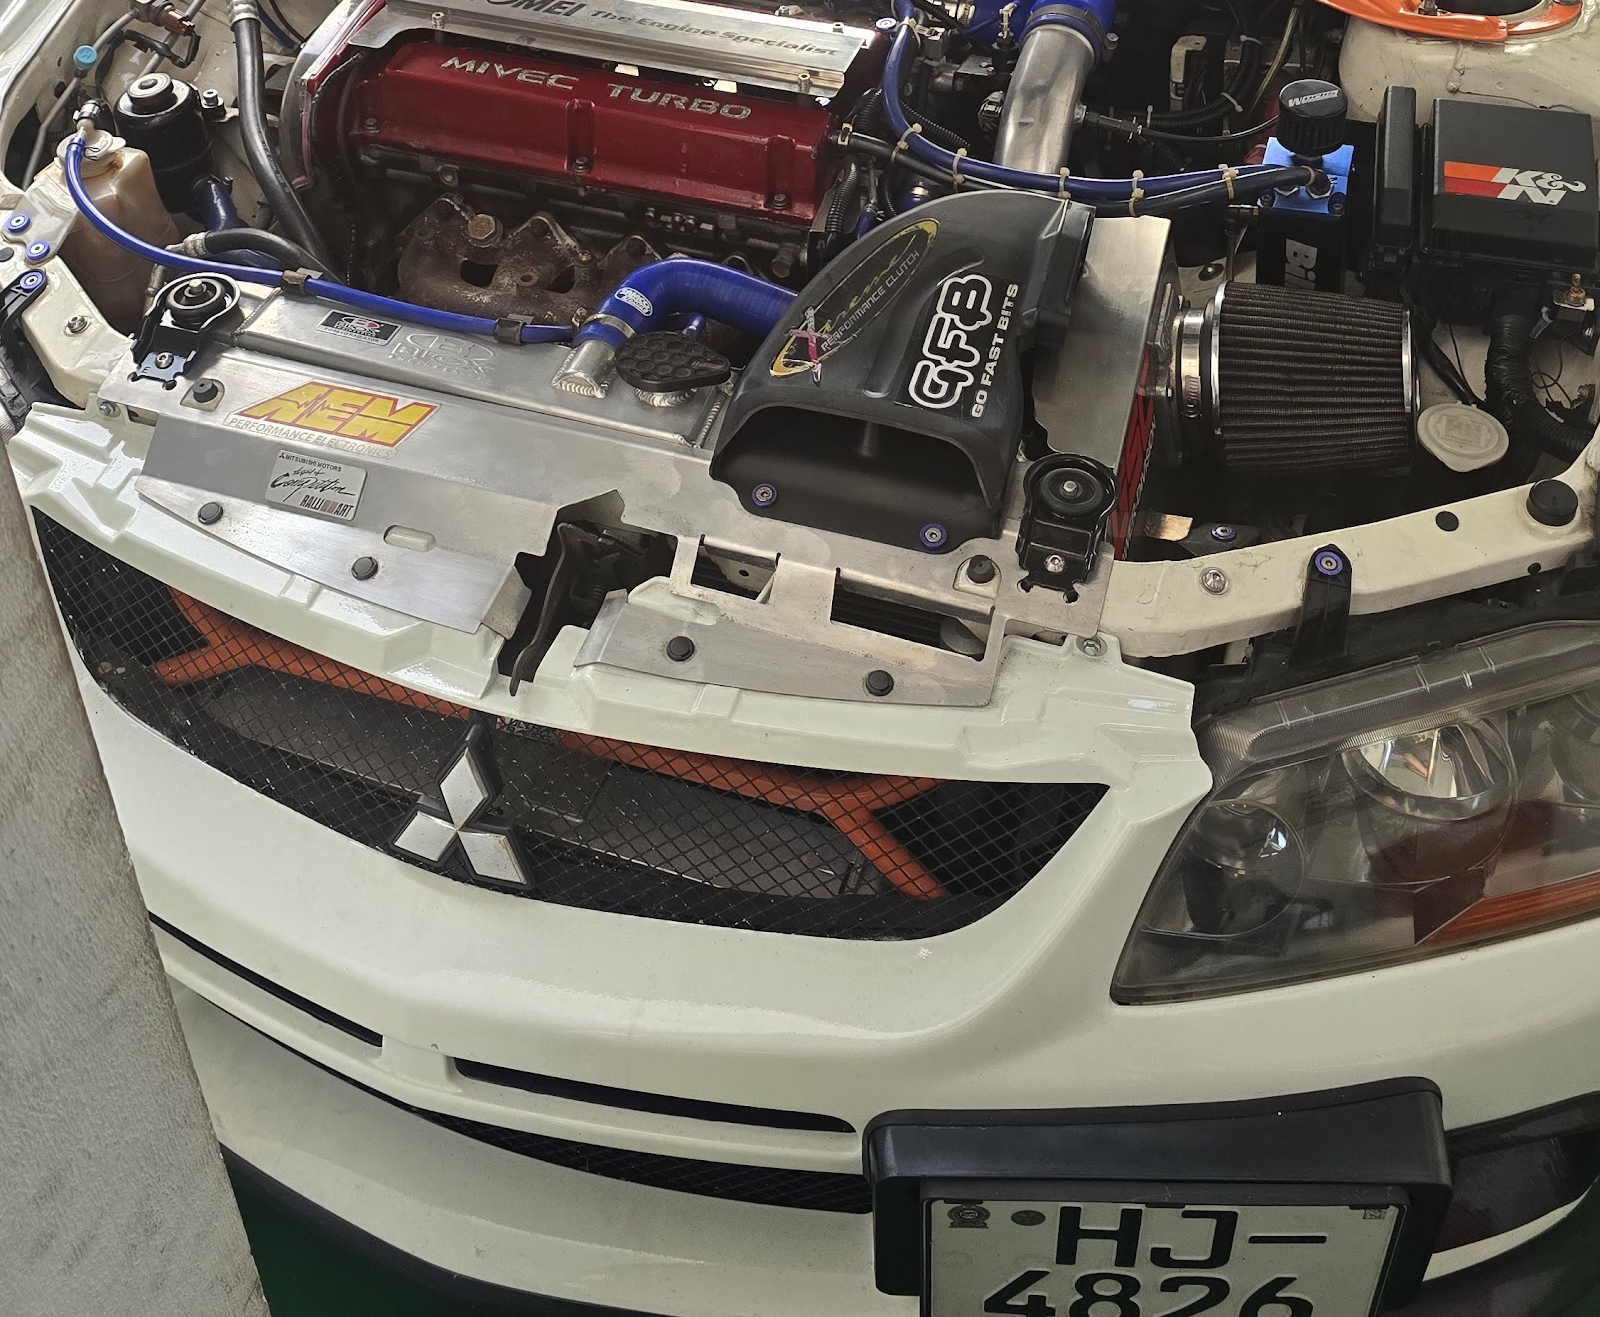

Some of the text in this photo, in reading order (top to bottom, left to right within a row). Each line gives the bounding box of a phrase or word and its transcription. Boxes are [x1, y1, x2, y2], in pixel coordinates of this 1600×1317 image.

[591, 9, 632, 23] The
[635, 17, 717, 38] Engine
[718, 30, 844, 57] Specialist
[440, 56, 751, 120] MIVEC TURBO
[1490, 167, 1587, 205] K&N
[885, 250, 920, 288] CLUTCH
[908, 274, 993, 409] GFB
[971, 283, 1019, 418] GO FAST BITS
[235, 381, 438, 448] AEM
[229, 417, 393, 460] PERFORMANCE ELECTRONICS
[286, 454, 342, 472] MITSUBISHI MOTORS
[982, 1270, 1315, 1317] 4826
